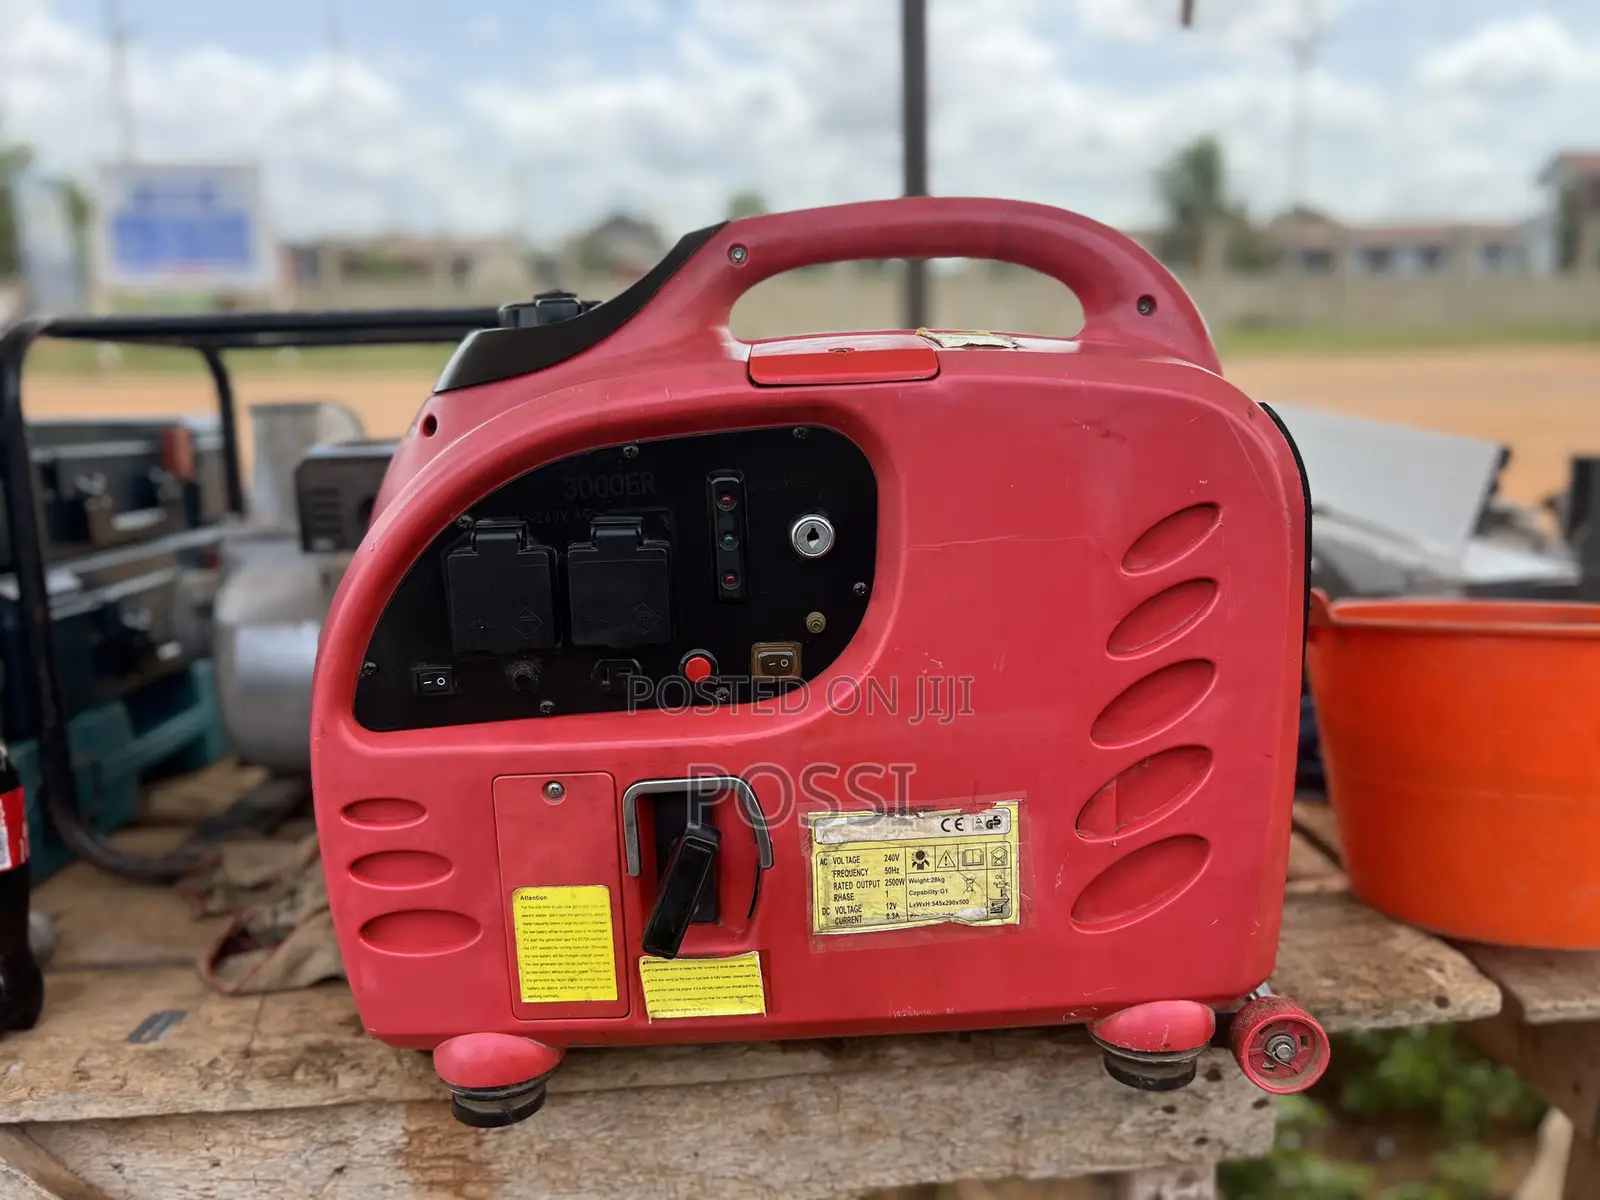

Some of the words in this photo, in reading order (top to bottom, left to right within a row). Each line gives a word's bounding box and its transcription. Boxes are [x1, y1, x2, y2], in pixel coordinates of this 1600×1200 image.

[564, 471, 657, 501] 3000ER
[941, 817, 964, 832] CE
[820, 858, 828, 866] AC
[884, 853, 900, 862] 240V
[832, 868, 869, 878] FREQUENCY
[884, 867, 900, 875] 50Hz
[833, 881, 853, 890] RATED
[856, 880, 880, 889] OUTPUT
[884, 878, 905, 887] 2500W
[821, 907, 831, 916] DC
[834, 904, 862, 915] VOLTAGE
[886, 902, 897, 910] 12V
[834, 915, 862, 926] CURRENT
